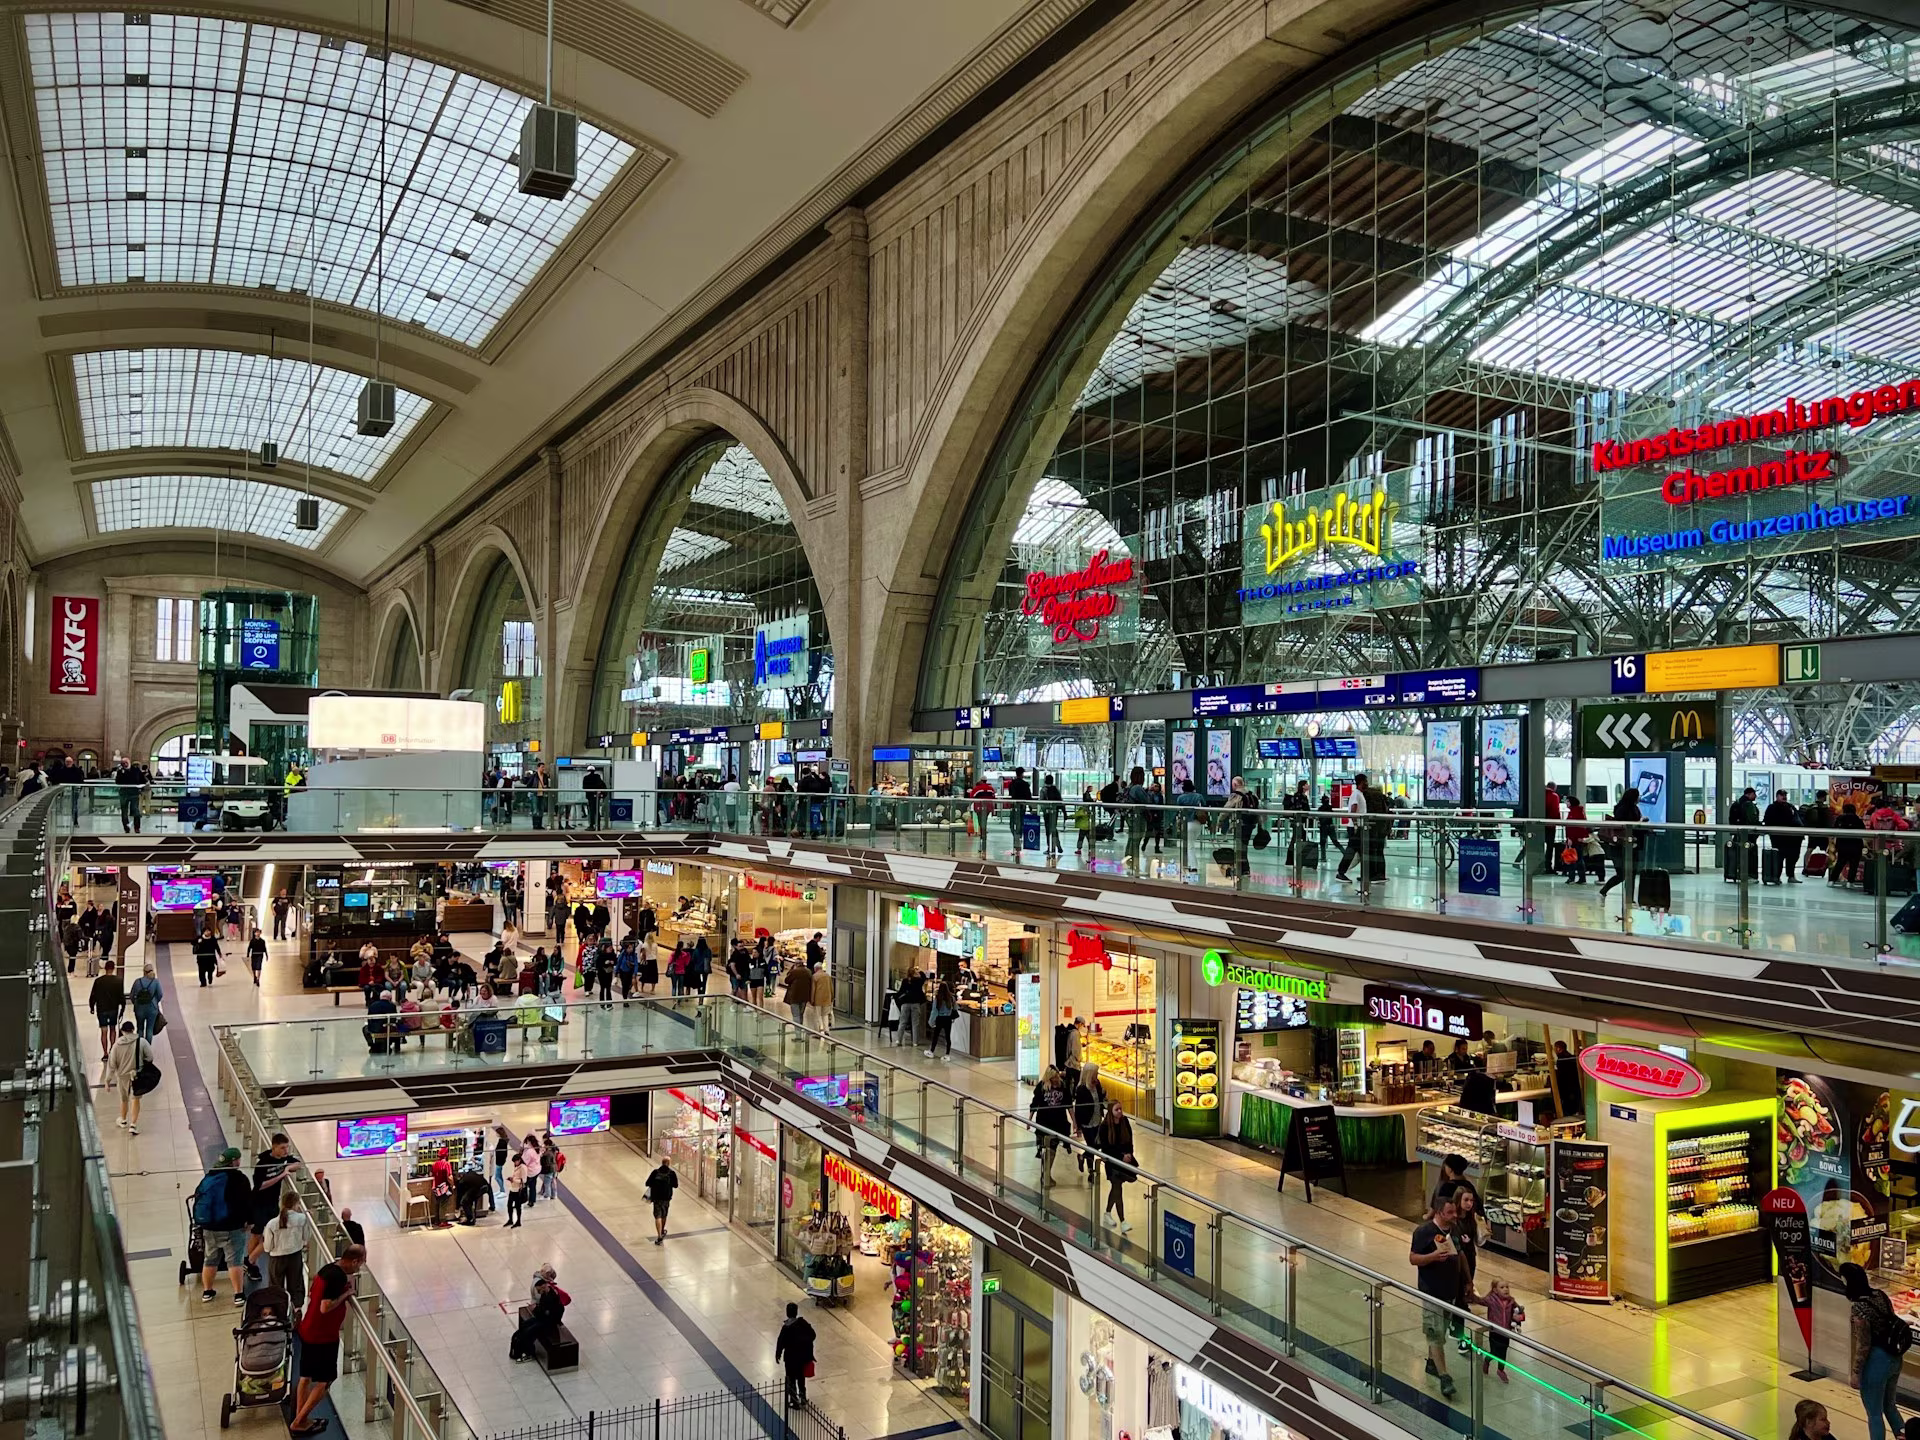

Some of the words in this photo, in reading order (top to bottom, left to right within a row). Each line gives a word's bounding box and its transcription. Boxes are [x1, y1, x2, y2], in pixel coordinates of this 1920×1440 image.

[1593, 379, 1920, 472] Kunstsammlungen
[1662, 449, 1834, 504] Chemnitz
[1604, 527, 1704, 558] Museum
[1709, 494, 1912, 544] Gunzenhauser
[1236, 561, 1418, 603] THOMANERCHOR
[1286, 597, 1353, 614] LEIPZIG
[63, 599, 86, 661] KFC
[768, 636, 802, 656] LEIPZIGER
[768, 658, 790, 675] MESSE
[1613, 655, 1637, 679] 16
[1112, 697, 1124, 711] 15
[972, 709, 980, 726] S
[982, 706, 991, 719] 14
[1832, 780, 1879, 792] Falafel
[1227, 965, 1327, 1002] asiagourmet
[1369, 994, 1423, 1027] sushi
[1448, 1014, 1465, 1027] and
[1448, 1024, 1471, 1037] more
[1498, 1125, 1518, 1137] Sushi
[1518, 1131, 1526, 1140] to
[1527, 1134, 1537, 1143] go
[1818, 1160, 1844, 1175] BOWLS
[824, 1154, 901, 1220] NANU-NANA
[1772, 1197, 1796, 1209] NEU
[1774, 1216, 1805, 1230] Kaffee
[1779, 1231, 1803, 1244] to-go
